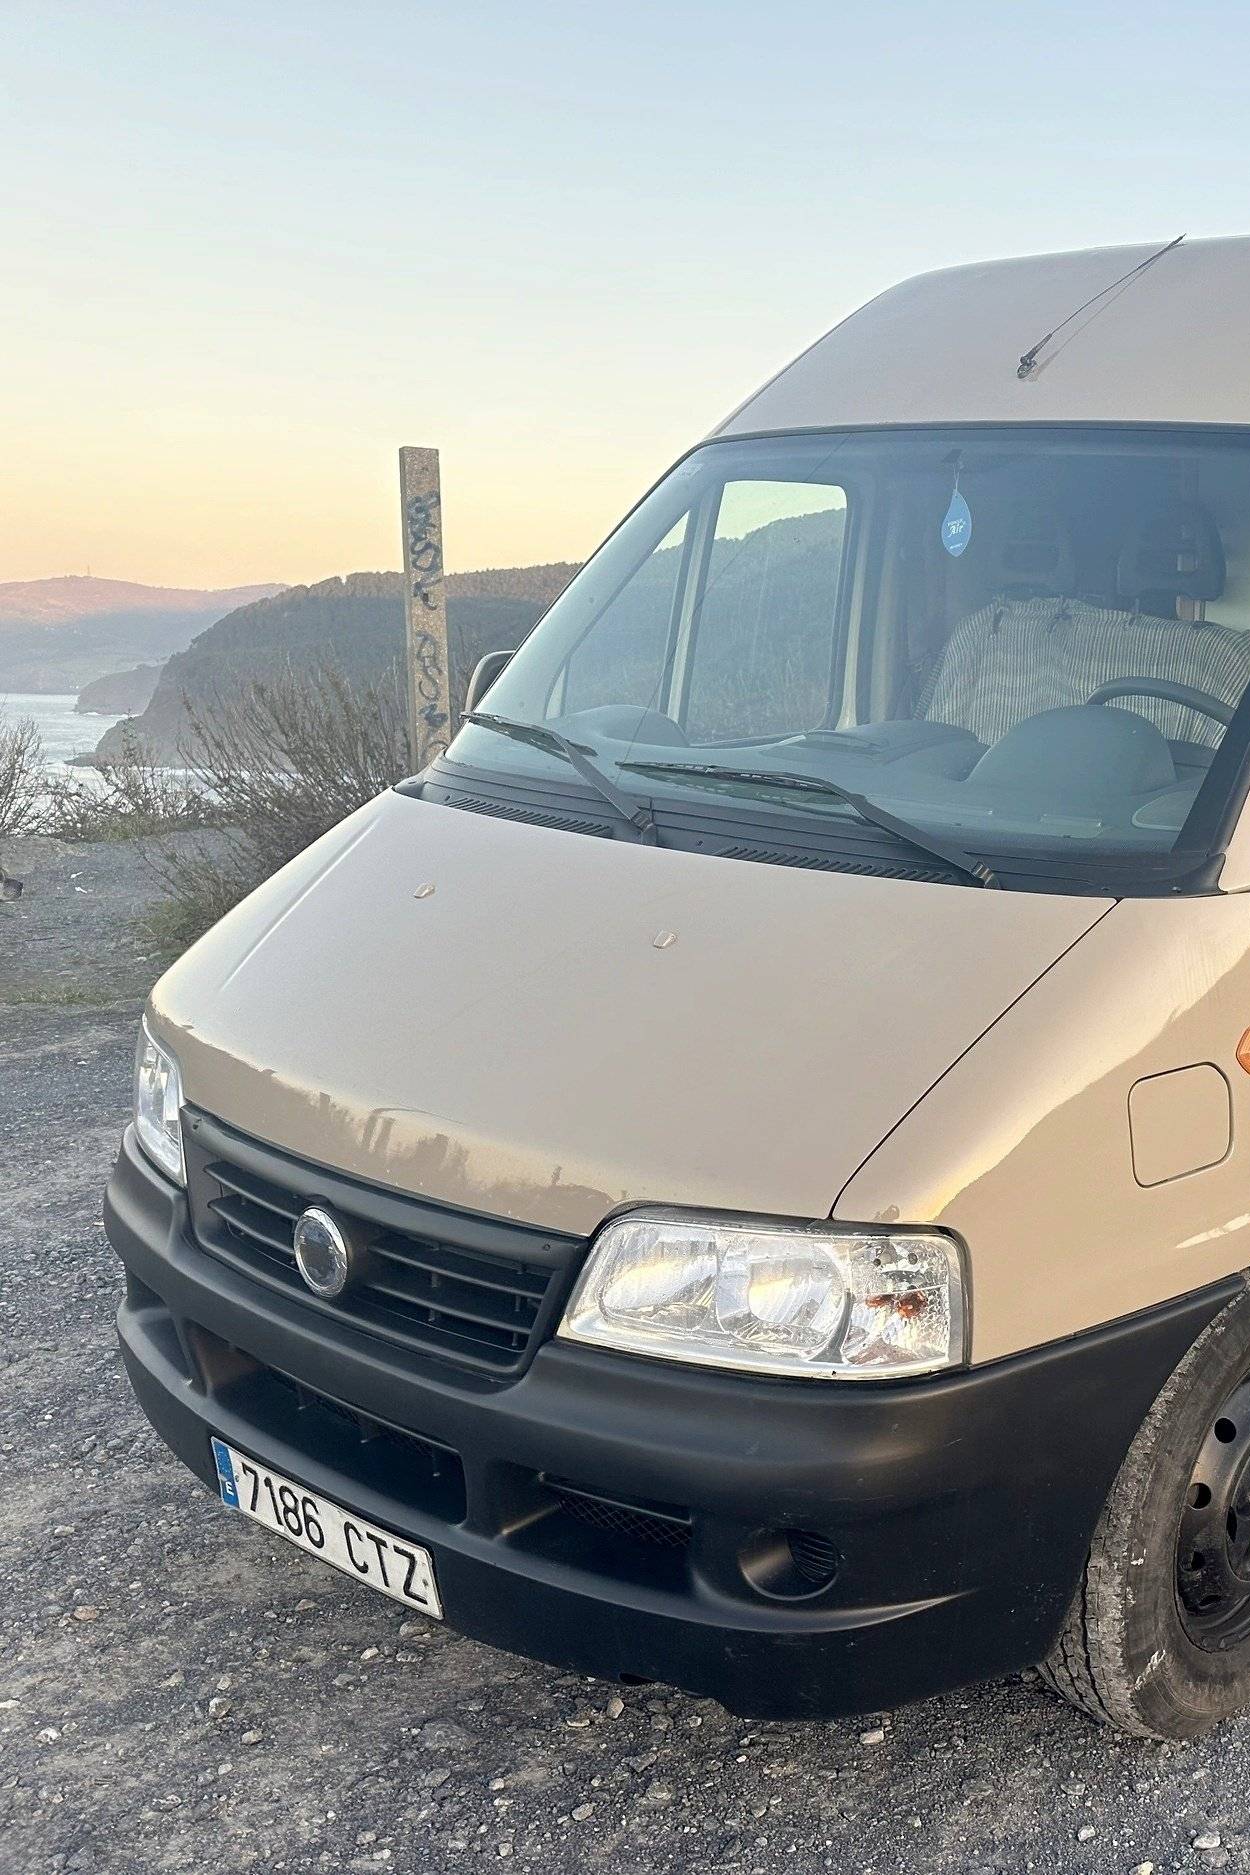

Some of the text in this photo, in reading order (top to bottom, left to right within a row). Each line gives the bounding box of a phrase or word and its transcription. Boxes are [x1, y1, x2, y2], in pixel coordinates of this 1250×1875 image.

[225, 1481, 235, 1496] E
[241, 1461, 428, 1605] 7186 CTZ
